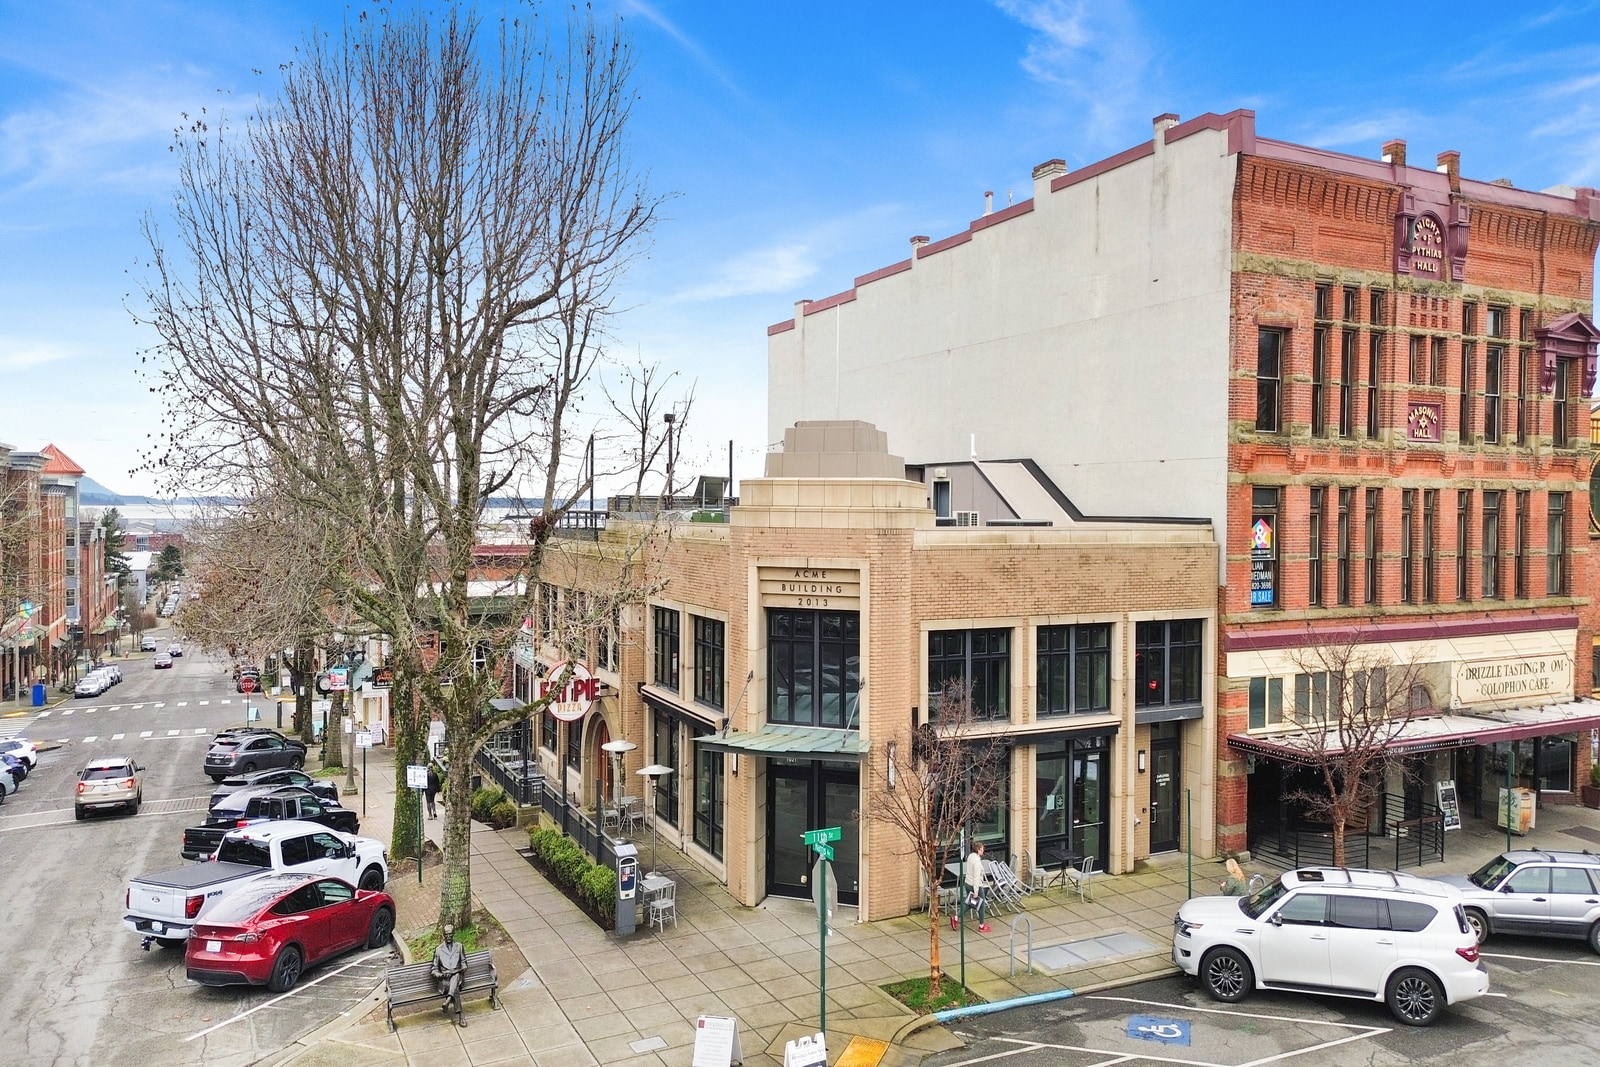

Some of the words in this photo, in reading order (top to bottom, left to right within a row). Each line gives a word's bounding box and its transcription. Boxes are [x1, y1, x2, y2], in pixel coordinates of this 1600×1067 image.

[1413, 218, 1442, 244] KNIGHTS
[1422, 233, 1433, 245] OF
[1412, 246, 1442, 259] PYTHIAS
[1417, 261, 1437, 272] HALL
[1408, 406, 1438, 424] MASONIC
[1414, 428, 1432, 438] HALL
[794, 570, 827, 578] ACME
[781, 583, 842, 593] BUILDING
[1258, 590, 1272, 602] SALE
[798, 598, 828, 607] 2013
[1465, 664, 1502, 680] DRIZZLE
[1503, 661, 1538, 677] TASTING
[1539, 659, 1564, 673] ROM
[242, 681, 254, 689] STOP
[573, 677, 600, 702] PIE
[1481, 679, 1528, 696] COLOPHON
[1529, 677, 1550, 691] CAFE
[557, 702, 582, 713] PIZZA
[813, 831, 828, 843] 11th
